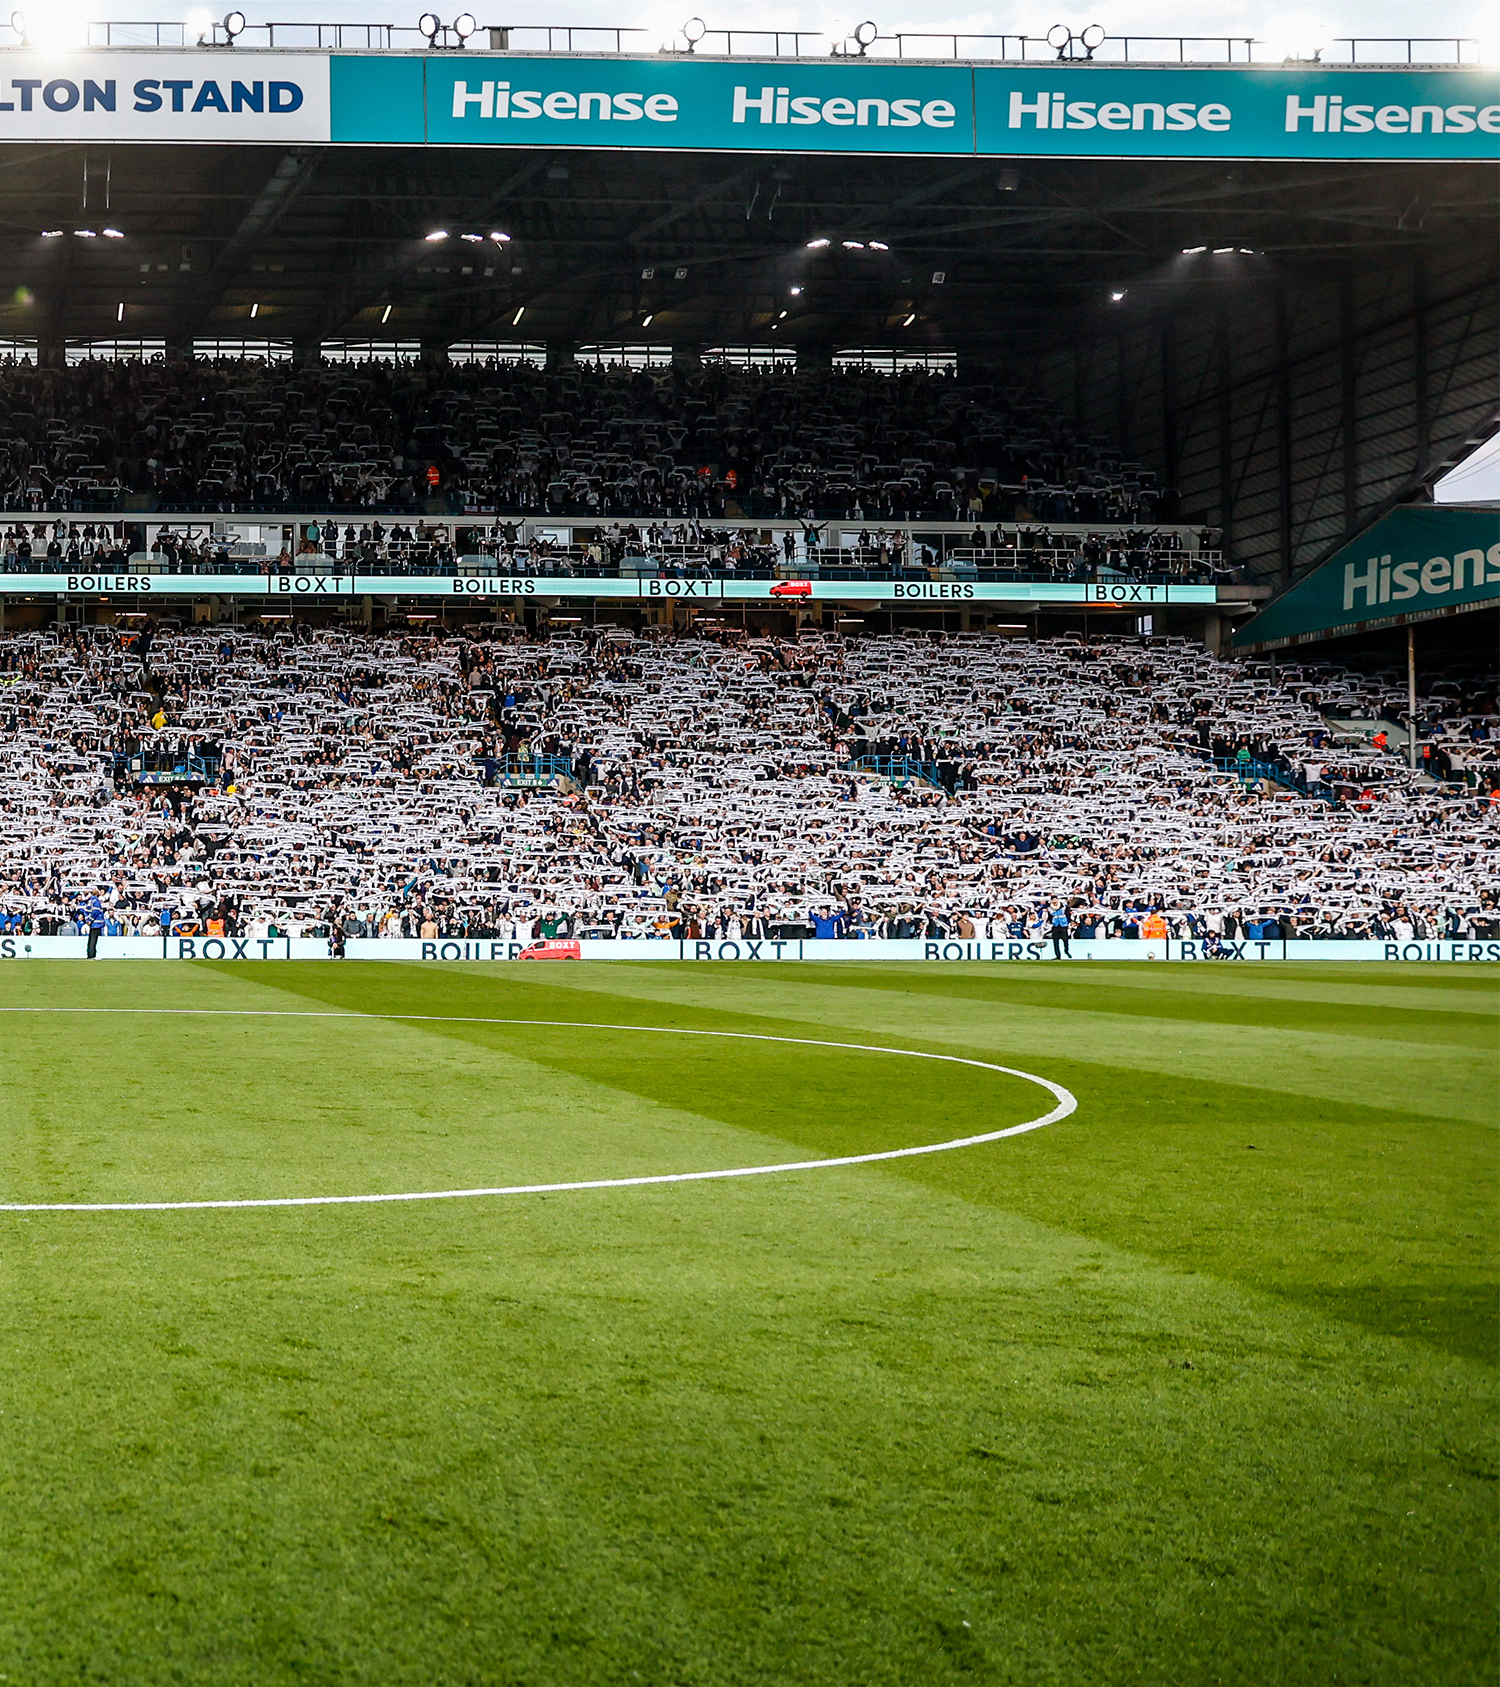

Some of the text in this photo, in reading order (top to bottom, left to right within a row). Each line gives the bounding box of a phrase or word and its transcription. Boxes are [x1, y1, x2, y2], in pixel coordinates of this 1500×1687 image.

[133, 79, 304, 113] STAND
[452, 81, 679, 122] Hisense
[732, 87, 956, 128] Hisense
[1008, 91, 1232, 132] Hisense
[1285, 94, 1500, 134] Hisense
[67, 577, 151, 591] BOILERS
[278, 576, 344, 592] BOXT
[453, 579, 535, 594] BOILERS
[649, 580, 713, 596] BOXT
[894, 584, 974, 598] BOILERS
[1096, 586, 1158, 602] BOXT
[179, 938, 274, 959] BOXT
[549, 941, 575, 949] BOXT
[695, 941, 787, 959] BOXT
[925, 942, 1040, 960] BOILERS
[1181, 941, 1271, 959] BXT
[1384, 943, 1500, 960] BOILERS
